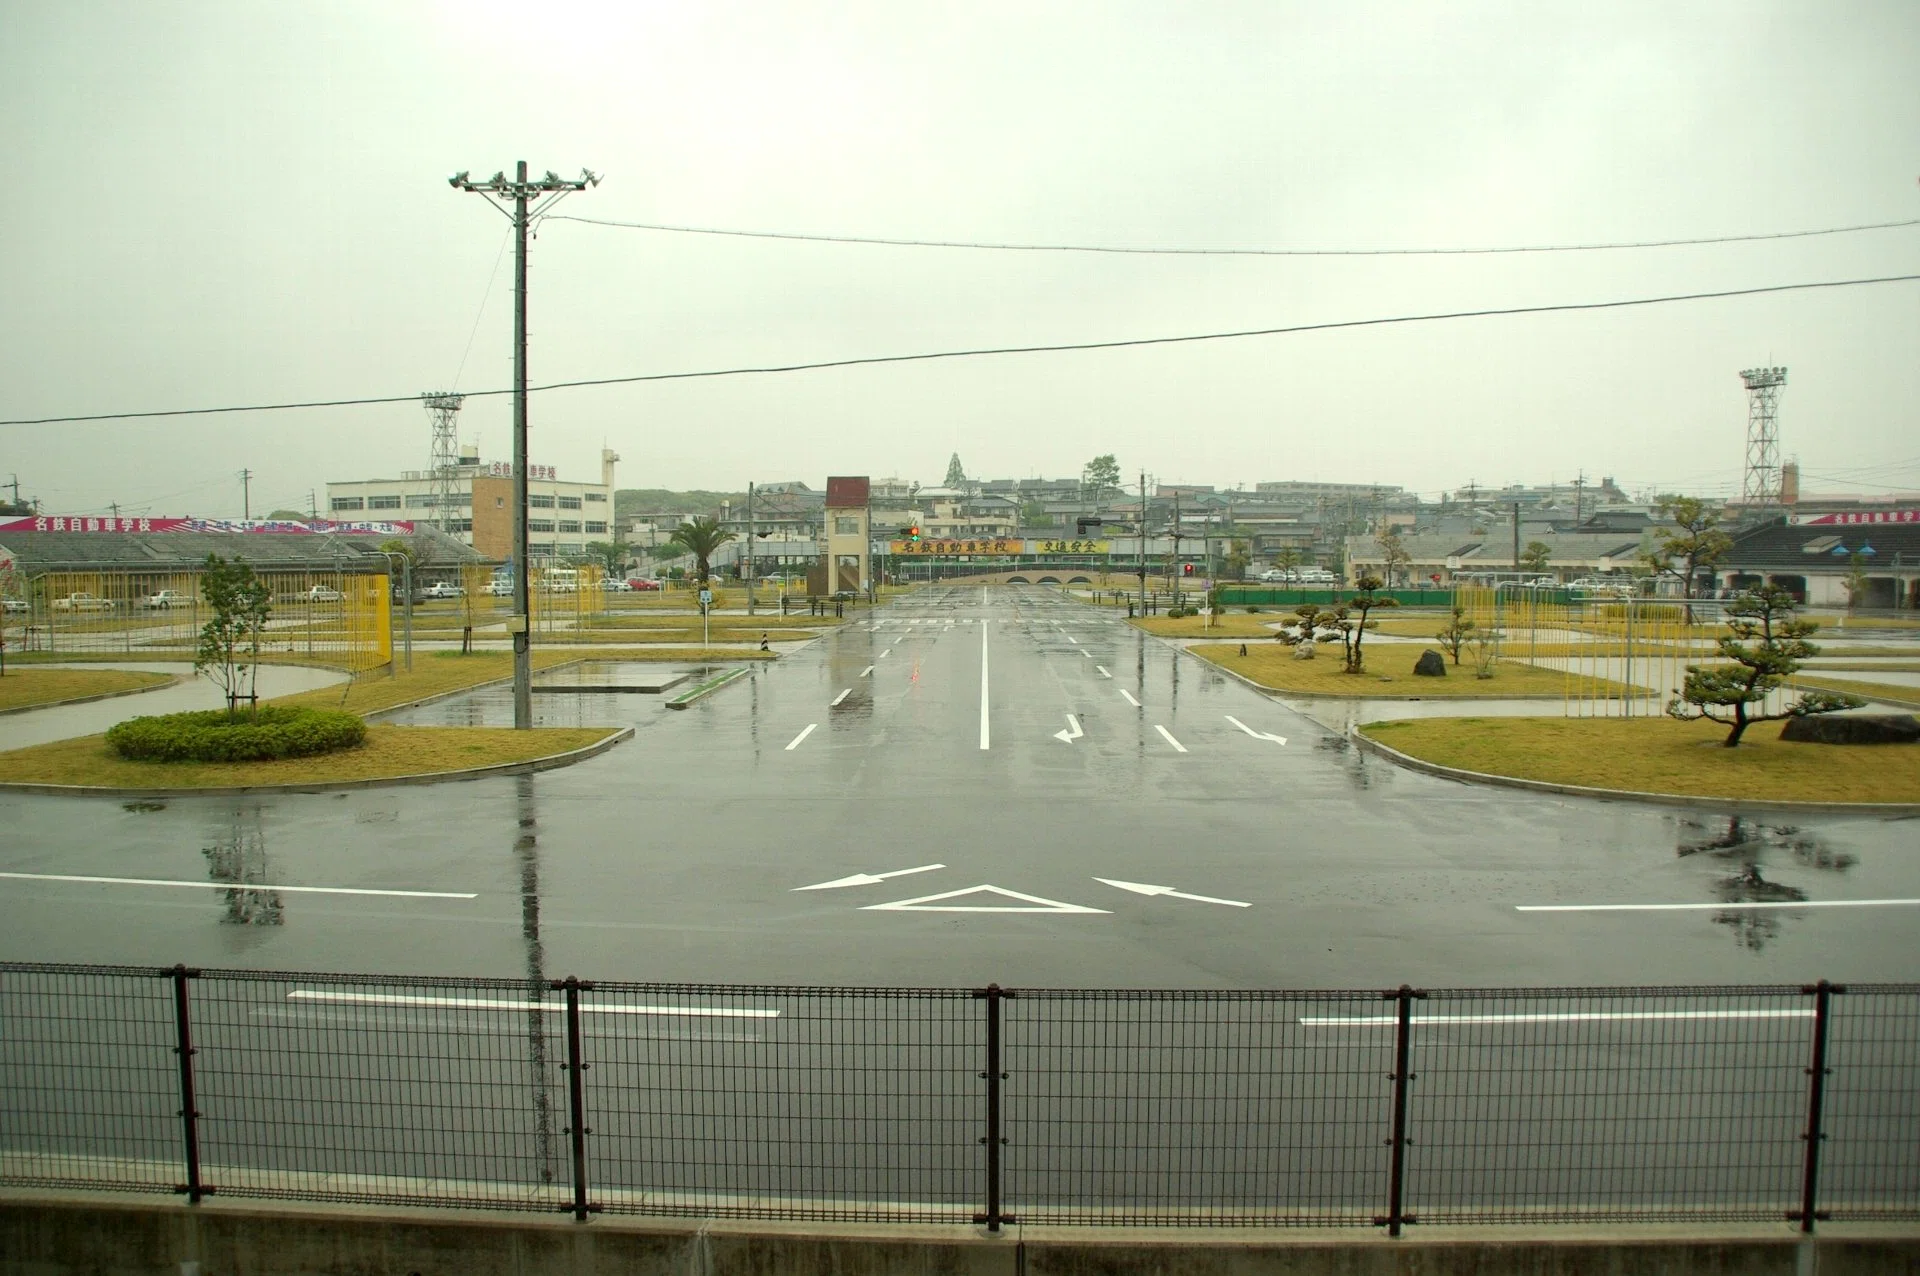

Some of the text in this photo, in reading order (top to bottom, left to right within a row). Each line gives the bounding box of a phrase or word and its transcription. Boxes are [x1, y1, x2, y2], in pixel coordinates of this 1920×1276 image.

[494, 461, 556, 478] 名鉄車学校
[34, 516, 151, 532] 名鉄自動車学校
[1834, 511, 1920, 524] 名鉄自動車学
[902, 540, 1009, 554] 名鉄自動車学校
[1043, 540, 1097, 553] 交通安全
